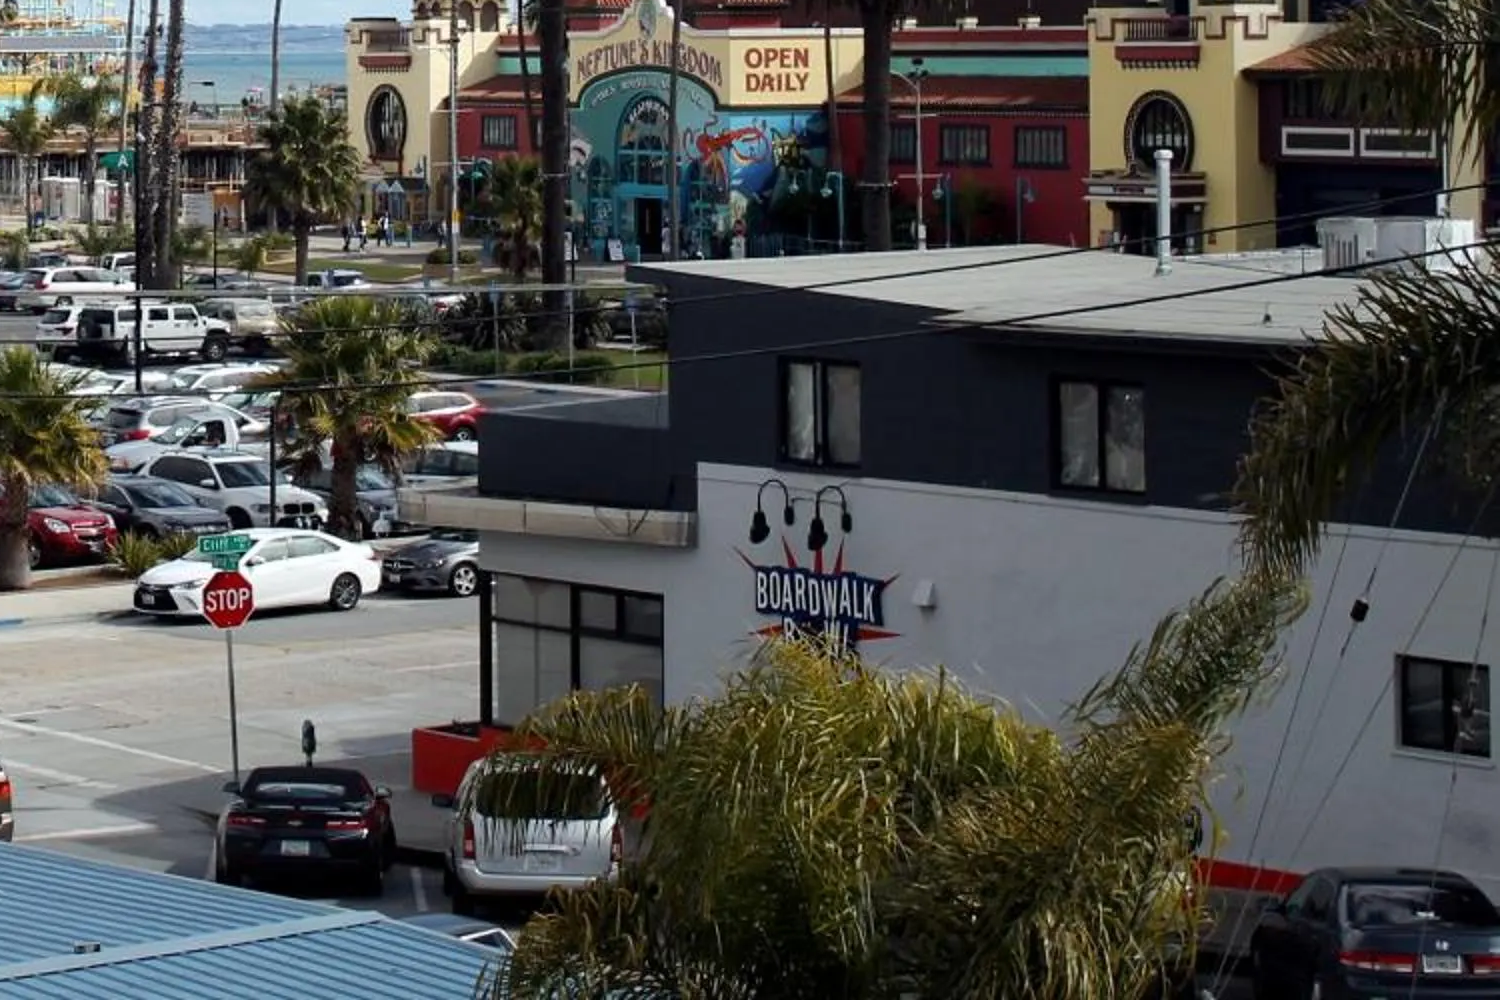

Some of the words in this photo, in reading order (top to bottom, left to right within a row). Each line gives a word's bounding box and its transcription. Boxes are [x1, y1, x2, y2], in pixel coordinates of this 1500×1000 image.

[577, 40, 649, 83] NEPTUNE'S
[744, 47, 809, 68] OPEN
[745, 72, 809, 92] DAILY
[118, 153, 129, 168] A
[206, 588, 250, 612] STOP
[757, 571, 875, 622] BOARDWALK
